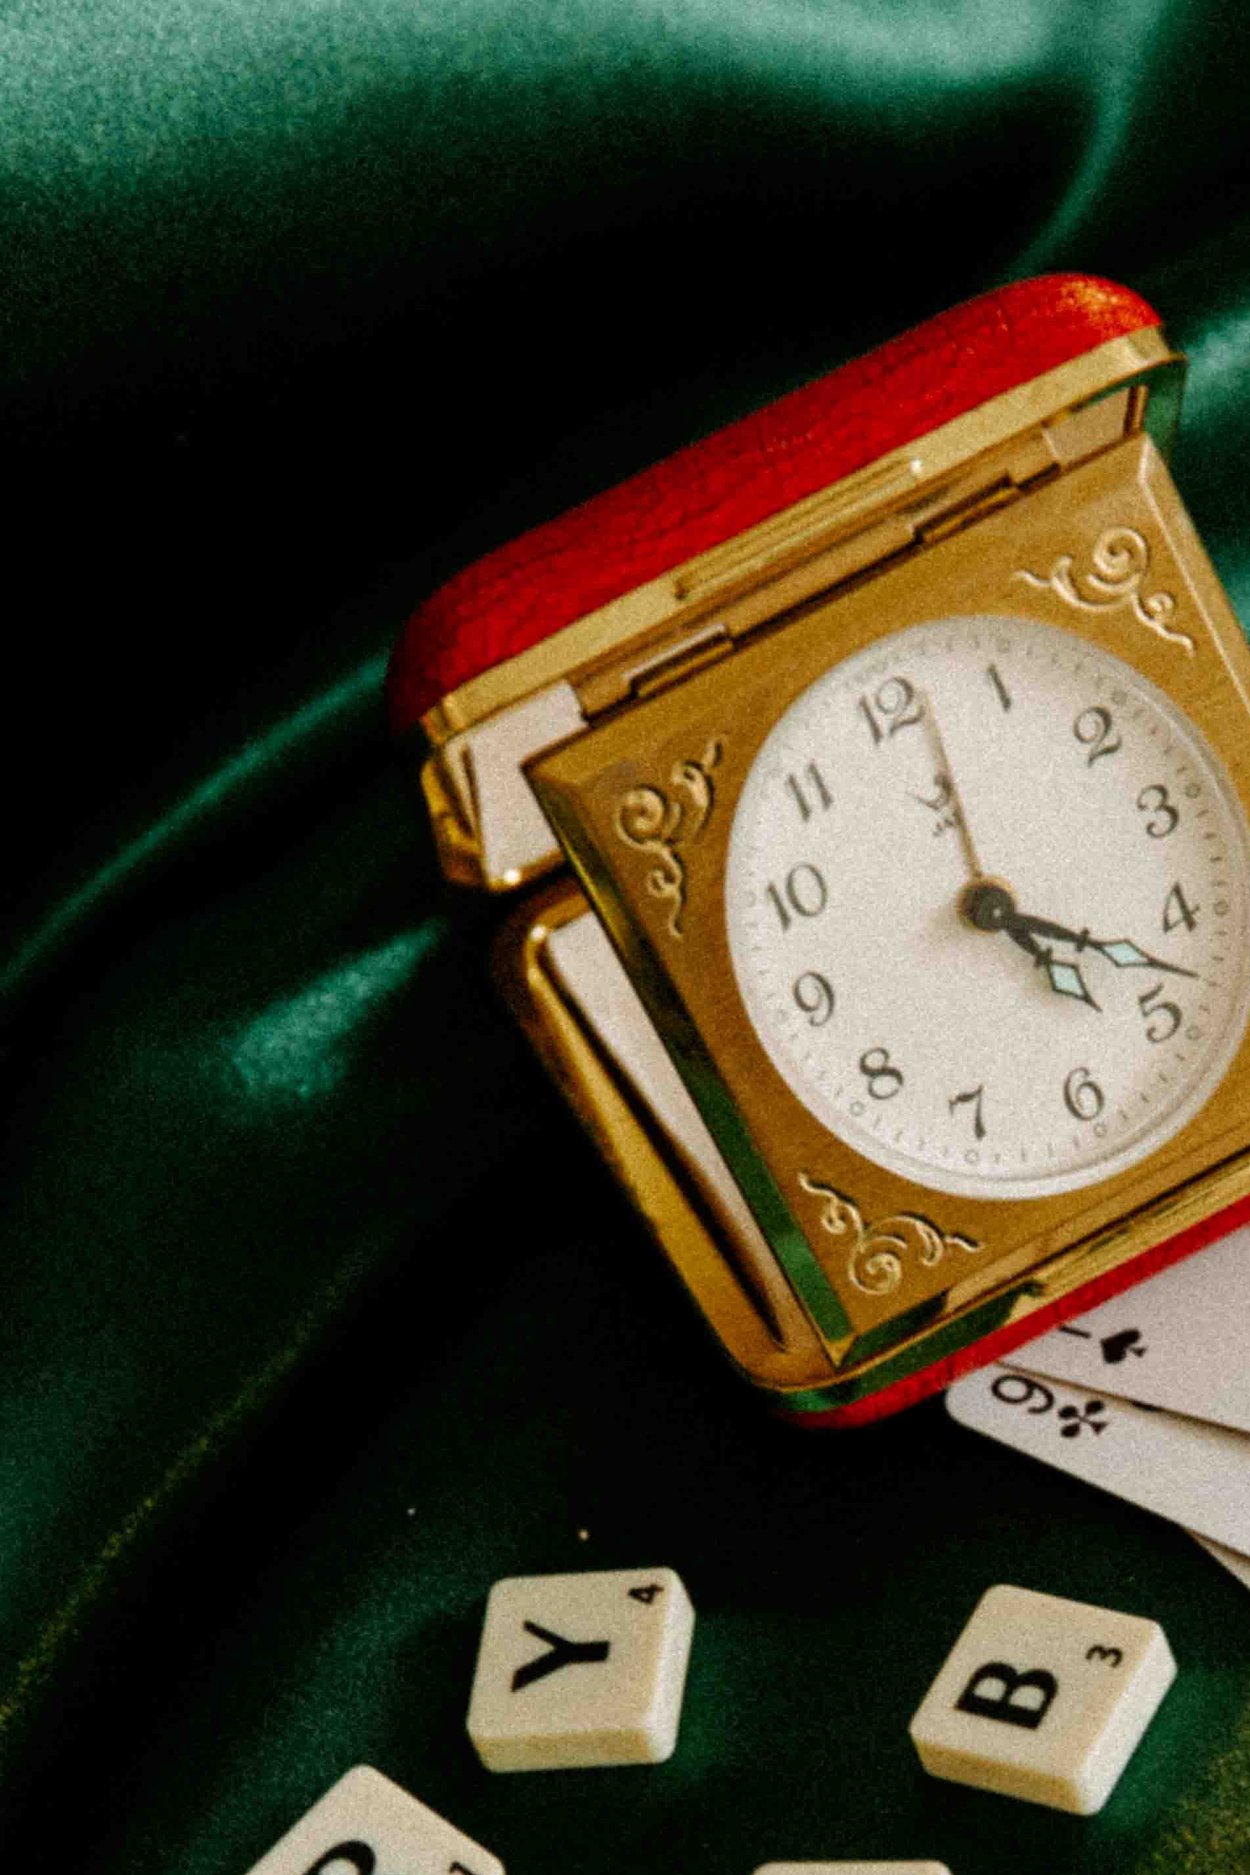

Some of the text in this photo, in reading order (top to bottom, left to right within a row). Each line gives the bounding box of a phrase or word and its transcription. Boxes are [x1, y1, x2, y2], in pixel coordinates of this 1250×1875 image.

[858, 675, 926, 745] 12
[984, 660, 1013, 713] 1
[1073, 705, 1122, 767] 2
[784, 761, 834, 824] 11
[1136, 783, 1181, 839] 3
[765, 863, 829, 932] 10
[1161, 881, 1202, 934] 4
[792, 970, 835, 1027] 9
[1136, 982, 1185, 1045] 5
[857, 1046, 905, 1101] 8
[1062, 1066, 1105, 1122] 6
[947, 1084, 988, 1141] 7
[509, 1582, 666, 1695] Y 4
[952, 1643, 1125, 1733] B 3
